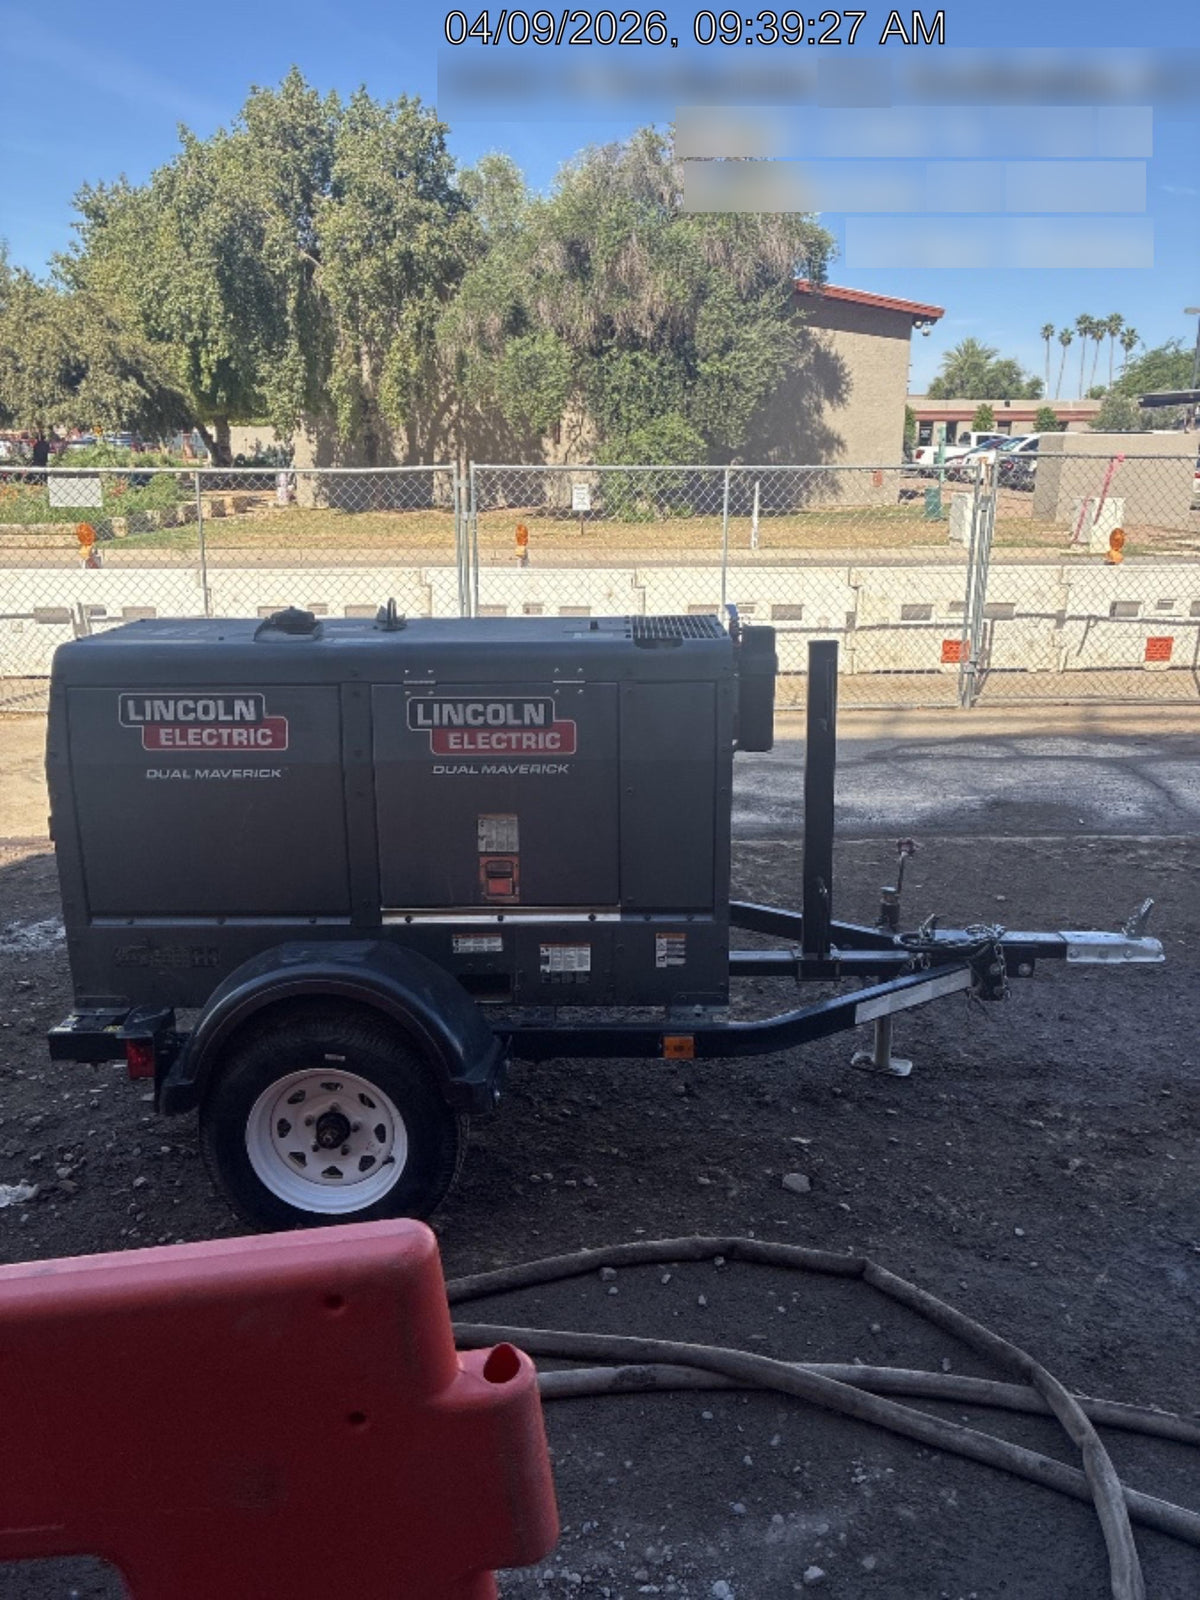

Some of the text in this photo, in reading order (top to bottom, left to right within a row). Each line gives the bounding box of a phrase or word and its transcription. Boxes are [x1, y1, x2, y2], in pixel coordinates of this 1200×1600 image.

[127, 699, 257, 721] LINCOLN
[416, 703, 545, 726] LINCOLN
[159, 728, 273, 746] ELECTRIC
[447, 732, 561, 750] ELECTRIC
[146, 769, 282, 779] DUAL MAVERICK
[432, 763, 570, 775] DUAL MAVERICK
